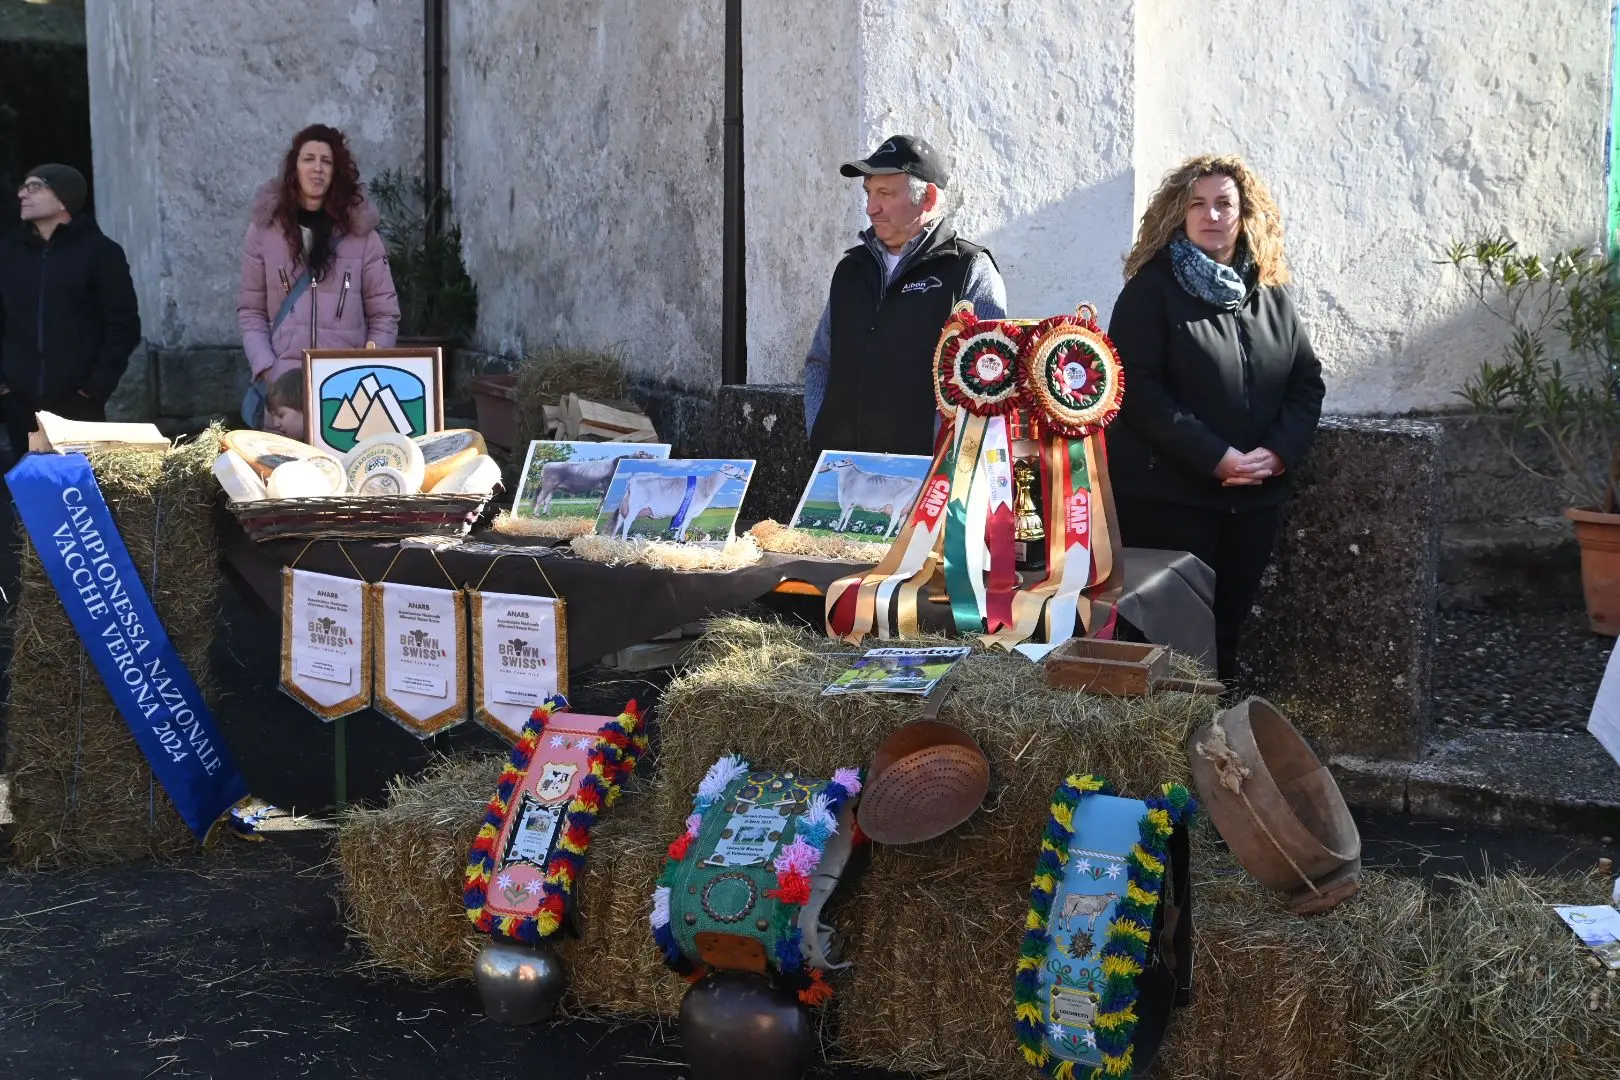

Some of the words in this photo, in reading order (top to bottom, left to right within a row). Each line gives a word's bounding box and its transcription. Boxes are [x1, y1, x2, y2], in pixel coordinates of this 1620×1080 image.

[926, 480, 950, 518] CMP
[1070, 494, 1088, 536] CMP
[62, 486, 150, 656] CAMPIONESSA
[144, 656, 222, 776] NAZIONALE
[308, 621, 347, 638] BROWN
[52, 520, 108, 620] VACCHE
[100, 620, 160, 720] VERONA
[152, 721, 188, 764] 2024
[311, 632, 344, 648] SWISS
[400, 634, 439, 649] BROWN
[403, 647, 436, 660] SWISS
[499, 644, 539, 658] BROWN
[502, 656, 536, 669] SWISS
